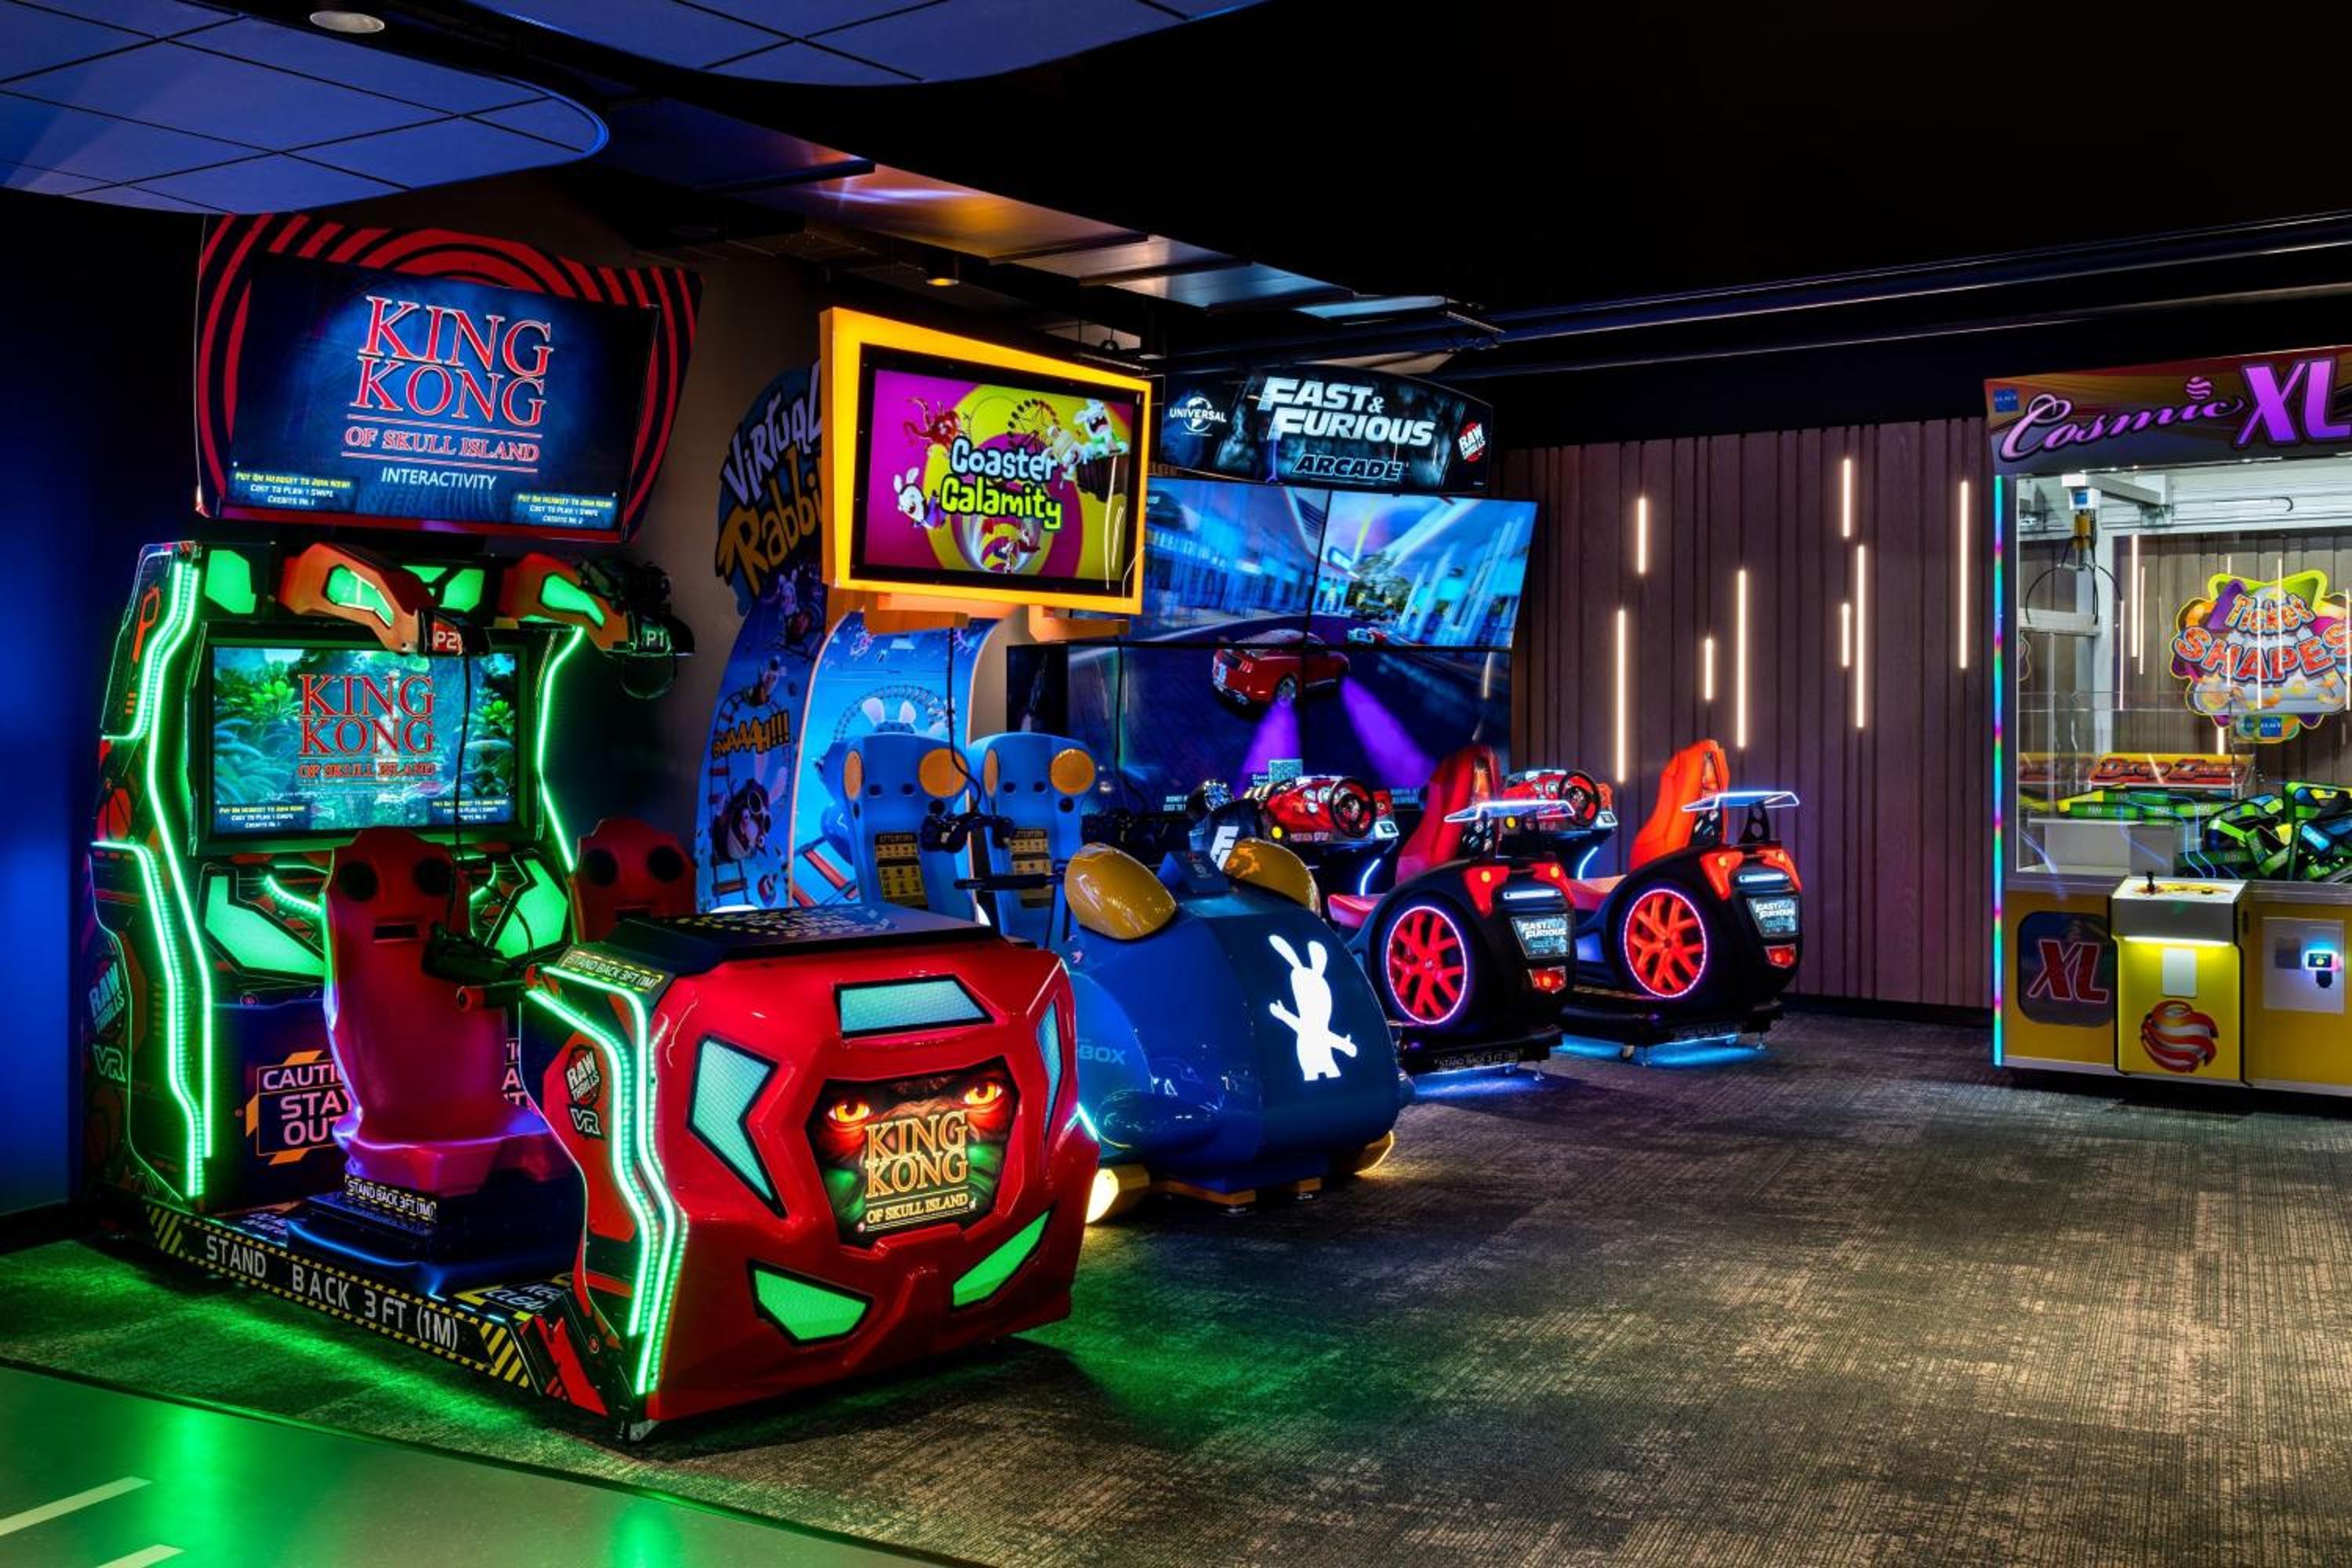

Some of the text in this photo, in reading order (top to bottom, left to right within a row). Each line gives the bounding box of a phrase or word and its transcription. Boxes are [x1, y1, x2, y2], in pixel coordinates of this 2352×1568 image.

[358, 295, 554, 378] KING
[350, 355, 546, 426] KONG
[1256, 376, 1385, 414] FAST &
[1168, 407, 1227, 424] UNIVERSAL
[1266, 406, 1437, 447] FURIOUS
[1999, 361, 2352, 461] Cosmic XL
[345, 426, 540, 461] OF SKULL ISLAND
[1459, 423, 1483, 452] RAW
[381, 466, 496, 490] INTERACTIVITY
[951, 437, 1058, 482] Coaster
[1292, 452, 1405, 482] ARCADE
[716, 445, 822, 597] Rabbi
[941, 475, 1062, 529] Calamity
[2224, 593, 2315, 633] Ticket
[435, 630, 459, 650] P2
[645, 630, 664, 647] P1
[2174, 622, 2352, 684] SHAPES
[297, 673, 436, 718] KING
[297, 714, 436, 757] KONG
[298, 760, 437, 779] OF SKULL ISLAND
[89, 962, 120, 1018] RAW
[2027, 938, 2109, 1004] XL
[92, 1044, 126, 1082] VR
[263, 1063, 342, 1091] CAUTI
[566, 1051, 597, 1091] RAW
[572, 1070, 601, 1102] THRILLS
[570, 1108, 601, 1136] VR
[866, 1110, 968, 1162] KING
[865, 1147, 968, 1198] KONG
[347, 1180, 376, 1199] STAND
[376, 1189, 398, 1207] BACK
[399, 1196, 415, 1212] 3FT
[866, 1192, 968, 1224] OF SKULL ISLAND
[205, 1235, 267, 1279] STAND
[292, 1263, 350, 1311] BACK
[416, 1305, 459, 1351] (1M)
